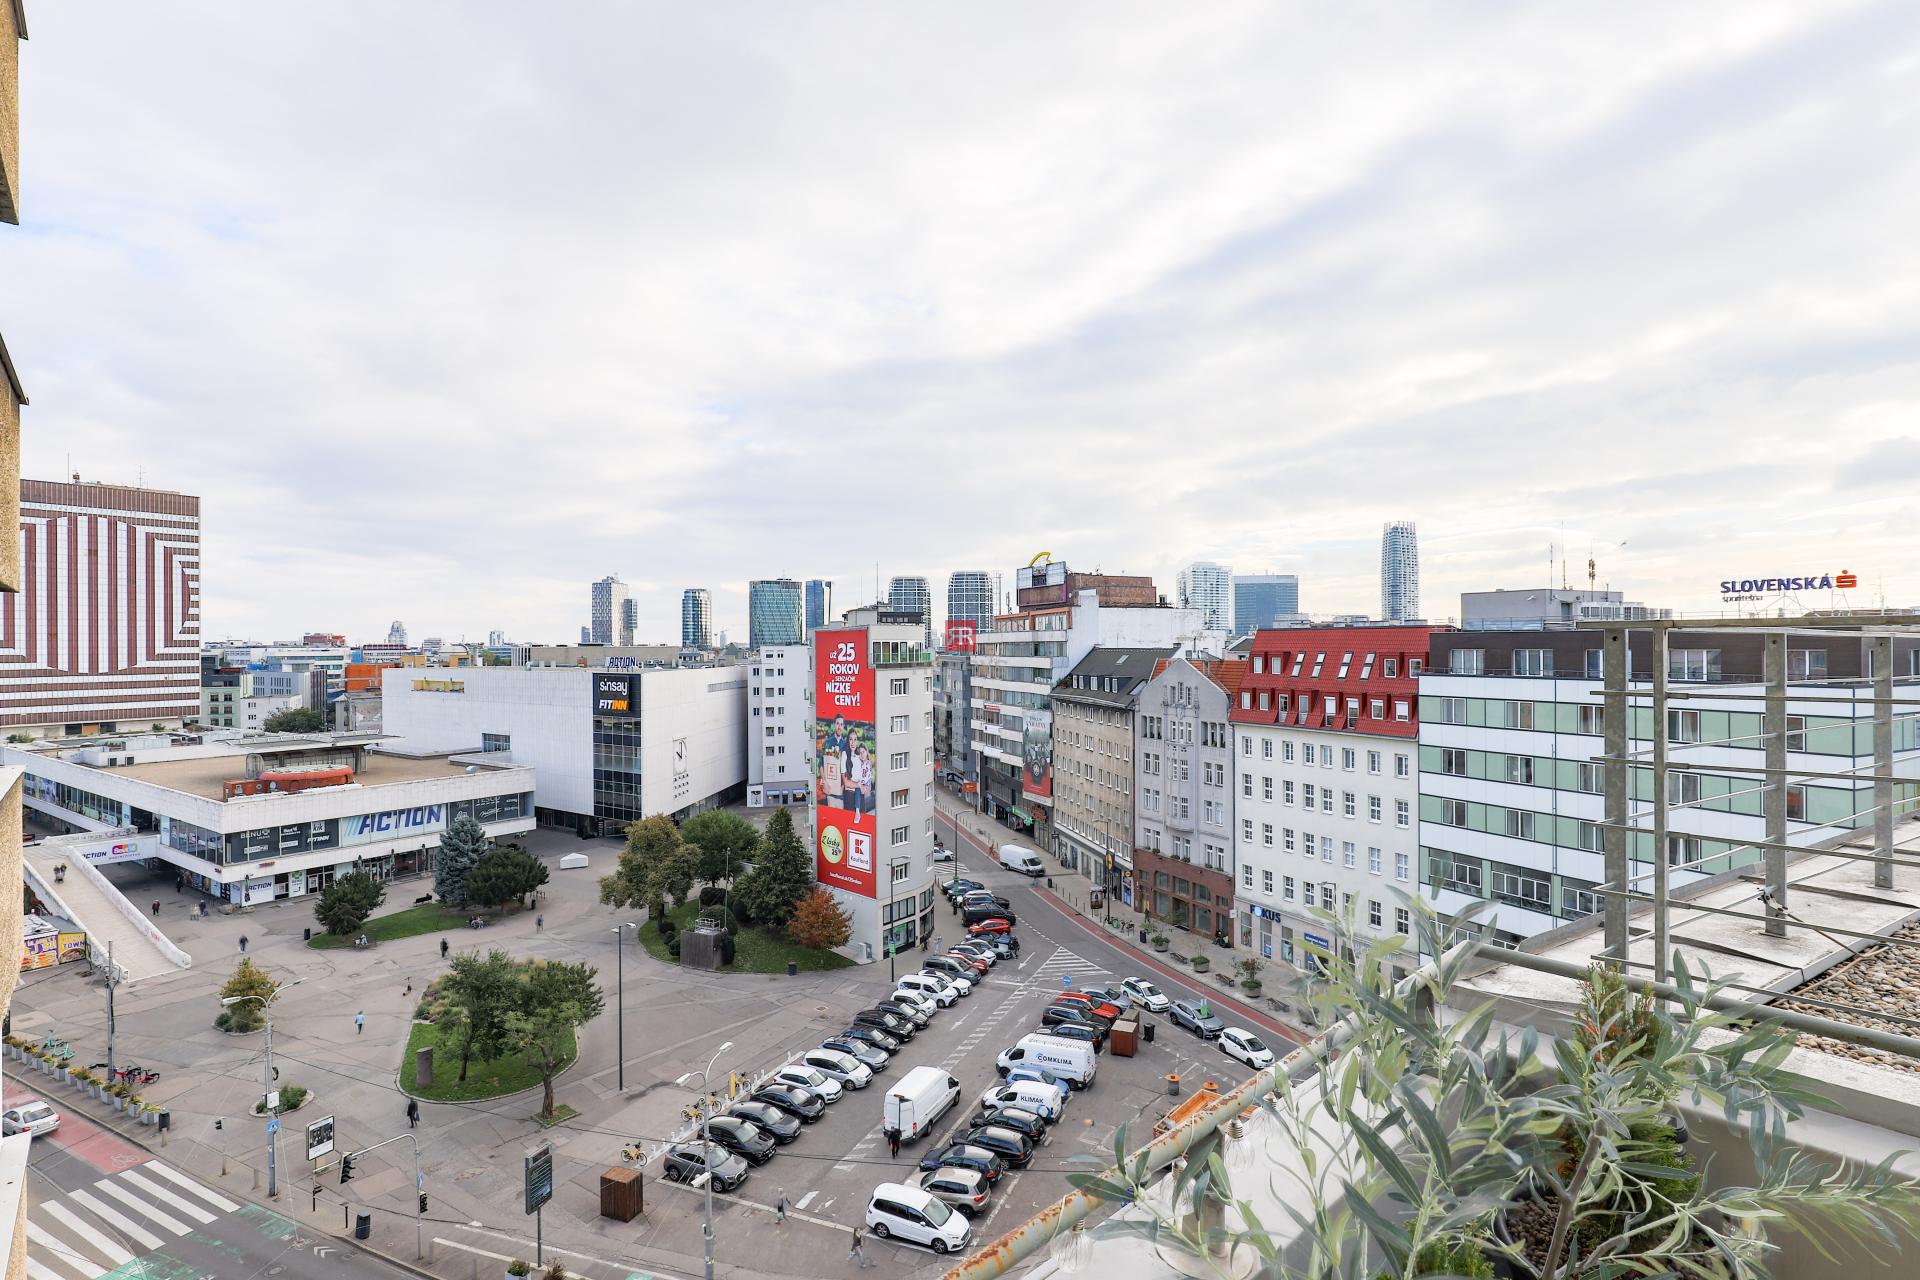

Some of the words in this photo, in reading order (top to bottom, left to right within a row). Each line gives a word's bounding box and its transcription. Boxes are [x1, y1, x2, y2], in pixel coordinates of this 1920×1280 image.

[1720, 573, 1832, 593] SLOVENSKÁ
[838, 643, 855, 661] 25
[609, 657, 635, 667] ACTION
[830, 664, 859, 674] ROKOV
[600, 678, 627, 695] sinsay
[826, 680, 850, 693] NÍZKE
[599, 700, 627, 710] FITINN
[835, 692, 860, 706] CENY!
[358, 806, 441, 834] ACTION
[1037, 1055, 1073, 1066] COMKLIMA
[1020, 1095, 1044, 1104] KLIMAK
